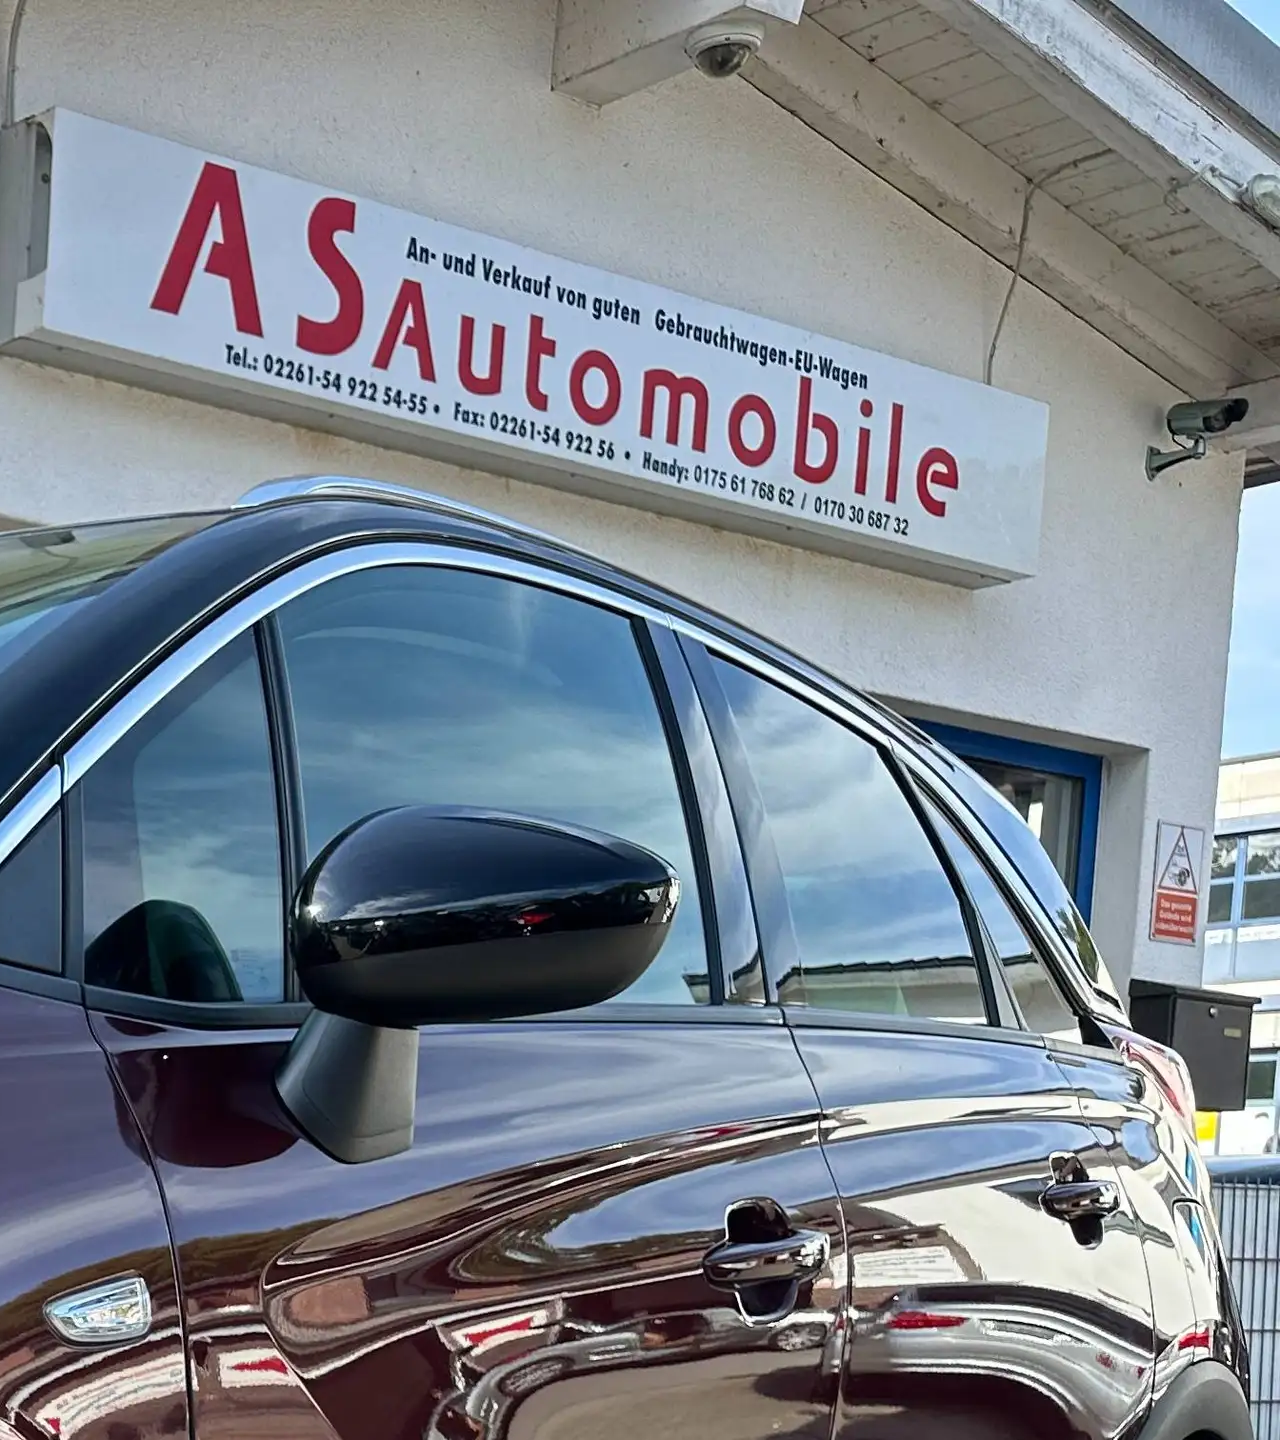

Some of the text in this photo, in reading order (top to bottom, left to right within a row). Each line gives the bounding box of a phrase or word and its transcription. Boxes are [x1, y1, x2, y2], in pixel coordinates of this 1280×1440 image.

[371, 277, 959, 518] Automobile
[406, 236, 869, 391] An- und Verkauf von guten Gebrauchtwagen-EU-Wagen
[225, 343, 259, 372] Tel.:
[263, 353, 342, 393] 02261-54
[347, 376, 378, 403] 922
[382, 386, 428, 416] 54-55
[453, 401, 486, 428] Fax:
[490, 410, 561, 448] 02261-54
[565, 430, 594, 456] 922
[596, 442, 616, 462] 56
[642, 450, 690, 484] Handy:
[693, 464, 727, 490] 0175
[730, 475, 746, 495] 61
[751, 479, 775, 502] 768
[778, 485, 795, 507] 62
[814, 496, 846, 520] 0170
[849, 504, 865, 525] 30
[867, 512, 892, 532] 687
[893, 517, 910, 537] 32
